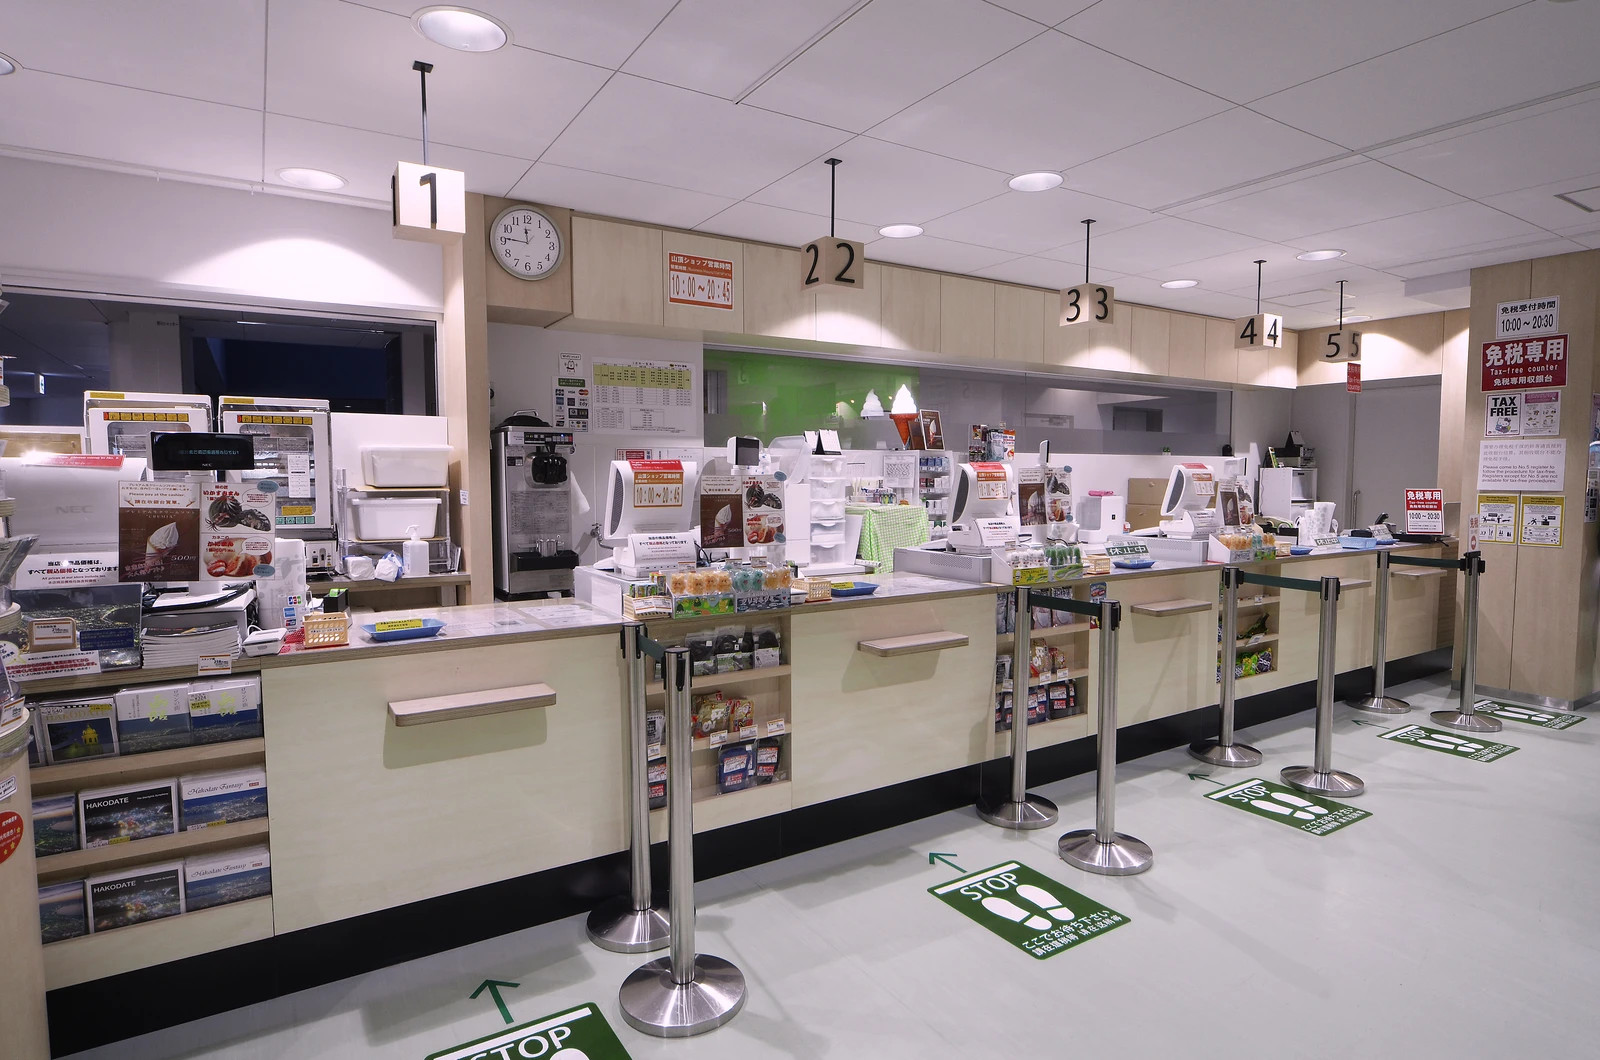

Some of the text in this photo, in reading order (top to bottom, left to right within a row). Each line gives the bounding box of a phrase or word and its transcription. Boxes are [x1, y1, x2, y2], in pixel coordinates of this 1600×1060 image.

[419, 172, 437, 224] 1
[512, 216, 519, 226] 11
[523, 215, 532, 224] 12
[537, 220, 542, 229] 1
[503, 224, 513, 233] 10
[545, 230, 551, 238] 2
[500, 237, 507, 245] 9
[549, 242, 555, 251] 3
[505, 249, 511, 258] 8
[545, 253, 551, 262] 4
[514, 259, 520, 267] 7
[525, 263, 531, 271] 6
[537, 262, 543, 270] 5
[671, 255, 731, 271] 山頂ショップ営業時間
[804, 243, 819, 285] 2
[834, 242, 856, 284] 2
[1065, 288, 1081, 323] 3
[1095, 287, 1108, 321] 3
[1501, 301, 1556, 314] 免税受付時間
[1240, 318, 1257, 344] 4
[1267, 318, 1279, 345] 4
[1325, 332, 1341, 358] 5
[1350, 332, 1359, 357] 5
[1485, 339, 1564, 368] 免税専用
[1490, 364, 1558, 376] Tax-free counter
[1492, 397, 1517, 406] TAX
[1490, 407, 1518, 417] FREE
[1407, 491, 1441, 500] 免税専用
[55, 505, 94, 514] NEC
[1110, 546, 1146, 556] 休止中
[187, 782, 244, 797] Hakodate Fantasy
[1228, 785, 1272, 803] STOP
[86, 797, 130, 810] HAKODATE
[190, 863, 247, 878] Hakodate Fantasy
[93, 880, 136, 893] HAKODATE
[959, 873, 1019, 900] STOP
[1022, 910, 1110, 949] ここでお待ち下さい
